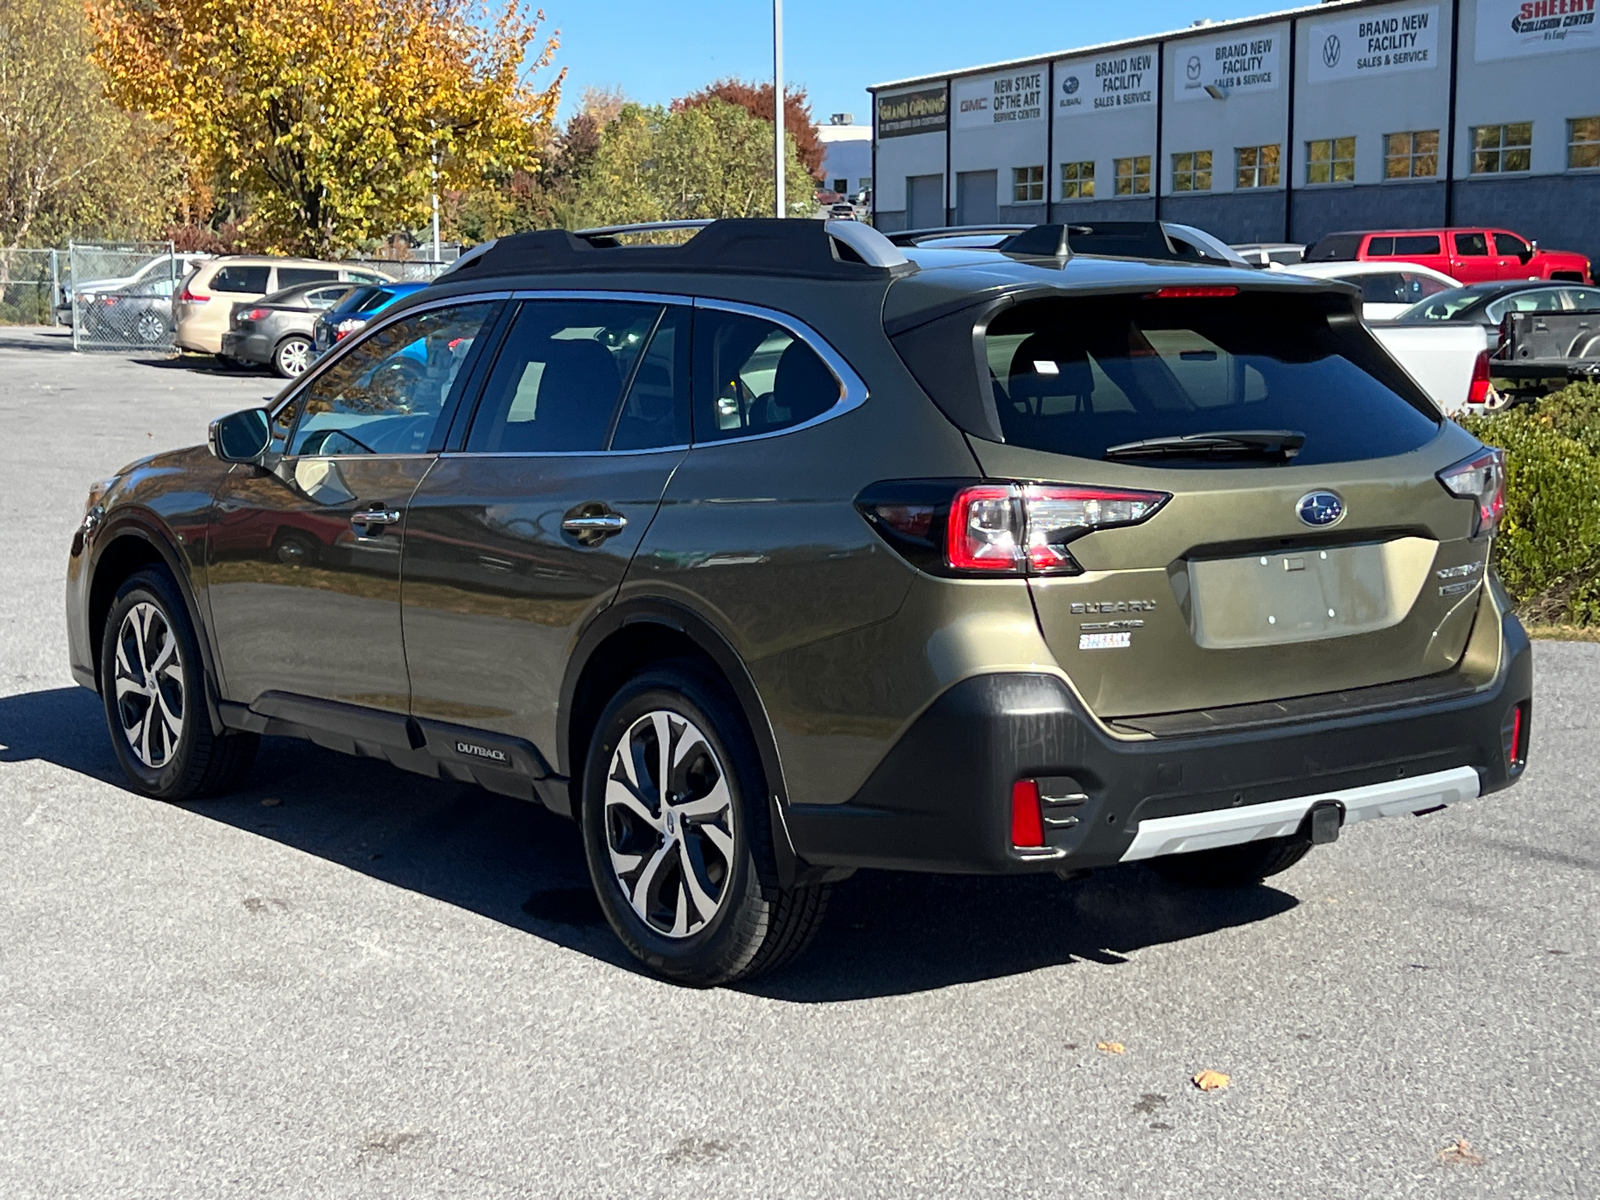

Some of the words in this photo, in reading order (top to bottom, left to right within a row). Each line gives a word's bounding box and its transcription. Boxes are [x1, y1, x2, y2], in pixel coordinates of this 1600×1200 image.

[1520, 0, 1595, 20] SHEEHY
[1359, 18, 1399, 38] BRAND
[1401, 13, 1429, 31] NEW
[1520, 17, 1562, 34] COLLISION
[1563, 12, 1595, 28] CENTER
[1215, 43, 1248, 61] BRAND
[1250, 38, 1272, 55] NEW
[1368, 31, 1417, 53] FACILITY
[1095, 59, 1127, 78] BRAND
[1129, 54, 1151, 72] NEW
[1222, 56, 1263, 75] FACILITY
[1356, 55, 1382, 69] SALES
[1384, 54, 1391, 65] &
[1392, 49, 1428, 65] SERVICE
[994, 78, 1013, 94] NEW
[1015, 73, 1040, 91] STATE
[1102, 72, 1143, 93] FACILITY
[1213, 76, 1235, 88] SALES
[1236, 75, 1241, 87] &
[1243, 72, 1272, 85] SERVICE
[880, 102, 908, 120] GRAND
[909, 97, 946, 116] OPENING
[960, 97, 988, 113] GMC
[993, 96, 1005, 111] OF
[1005, 94, 1022, 109] THE
[1023, 91, 1041, 107] ART
[1093, 95, 1115, 109] SALES
[1116, 94, 1121, 106] &
[1123, 91, 1151, 105] SERVICE
[993, 110, 1017, 124] SERVICE
[1017, 107, 1041, 120] CENTER
[1070, 598, 1156, 614] SUBARU
[457, 742, 506, 761] OUTBACK
